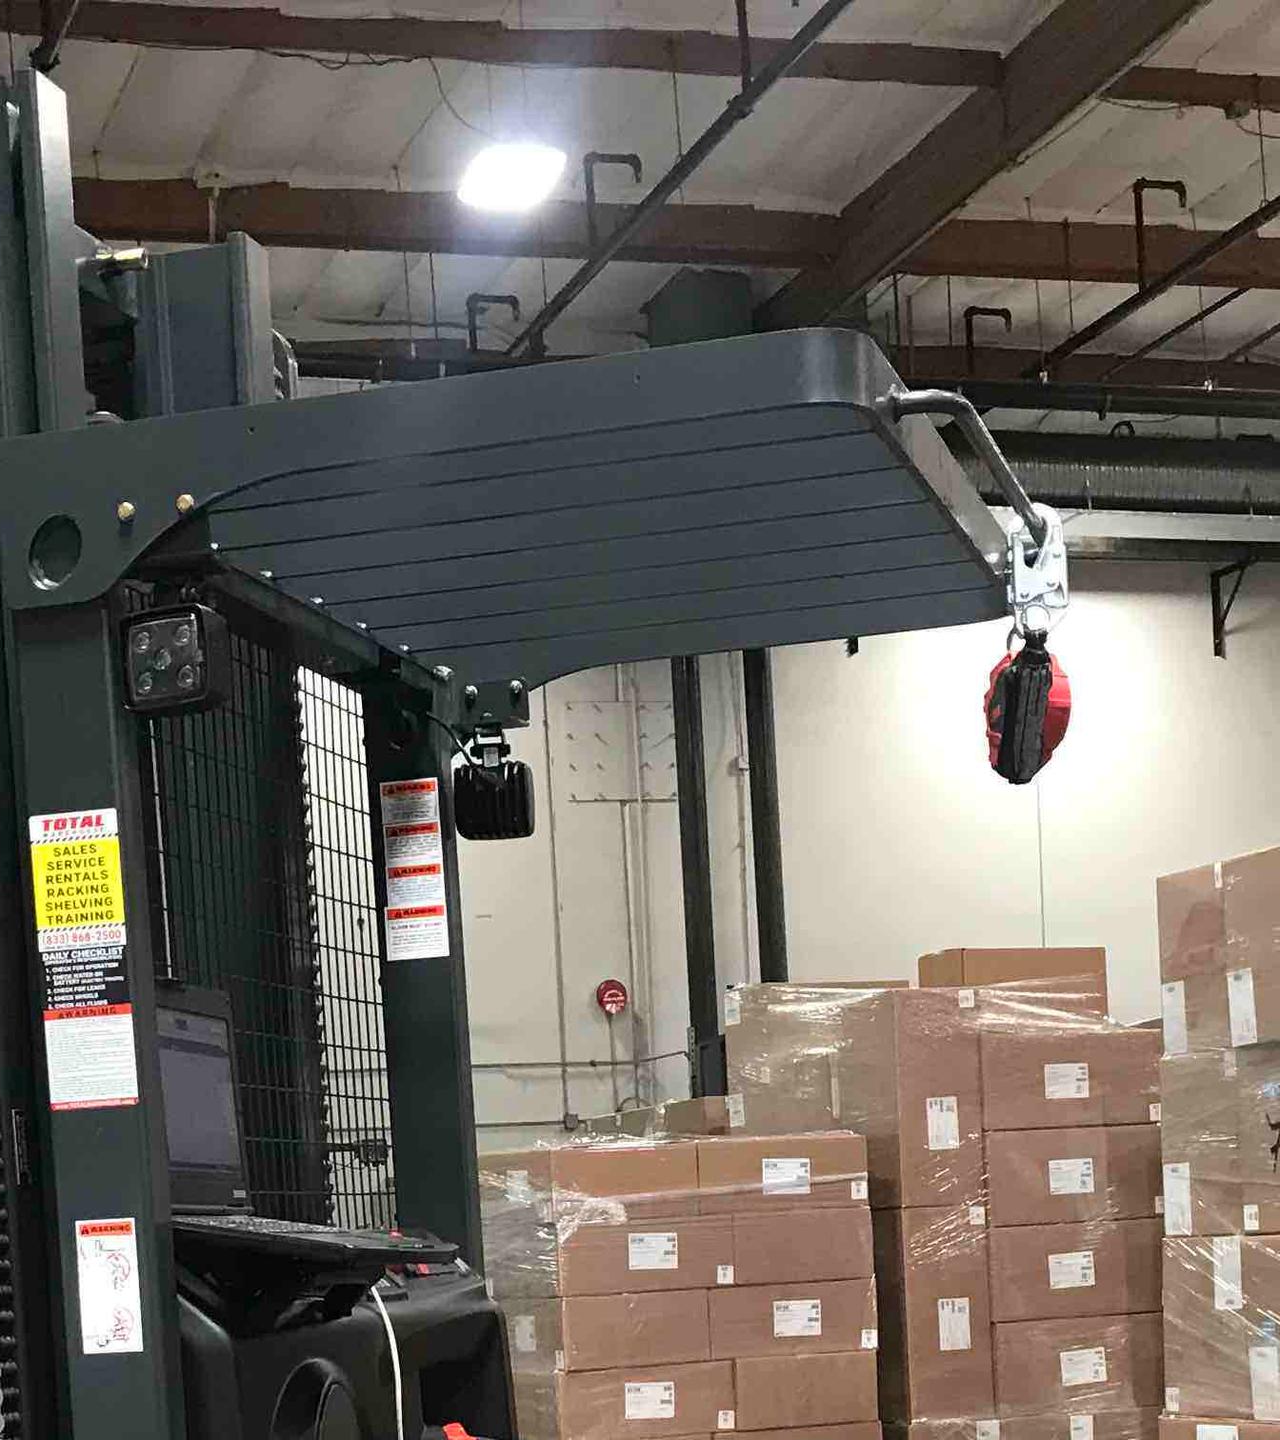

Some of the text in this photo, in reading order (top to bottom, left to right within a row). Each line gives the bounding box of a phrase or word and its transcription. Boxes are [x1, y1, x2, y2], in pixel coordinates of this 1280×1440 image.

[41, 815, 104, 831] TOTAL
[53, 844, 97, 857] SALES
[46, 856, 106, 871] SERVICE
[46, 869, 109, 885] RENTALS
[47, 883, 110, 898] RACKING
[45, 896, 113, 912] SHELVING
[46, 910, 115, 926] TRAINING
[42, 951, 69, 962] DAILY
[71, 946, 124, 959] CHECKLIST
[65, 1007, 116, 1016] WARNING
[91, 1224, 131, 1233] WARNING
